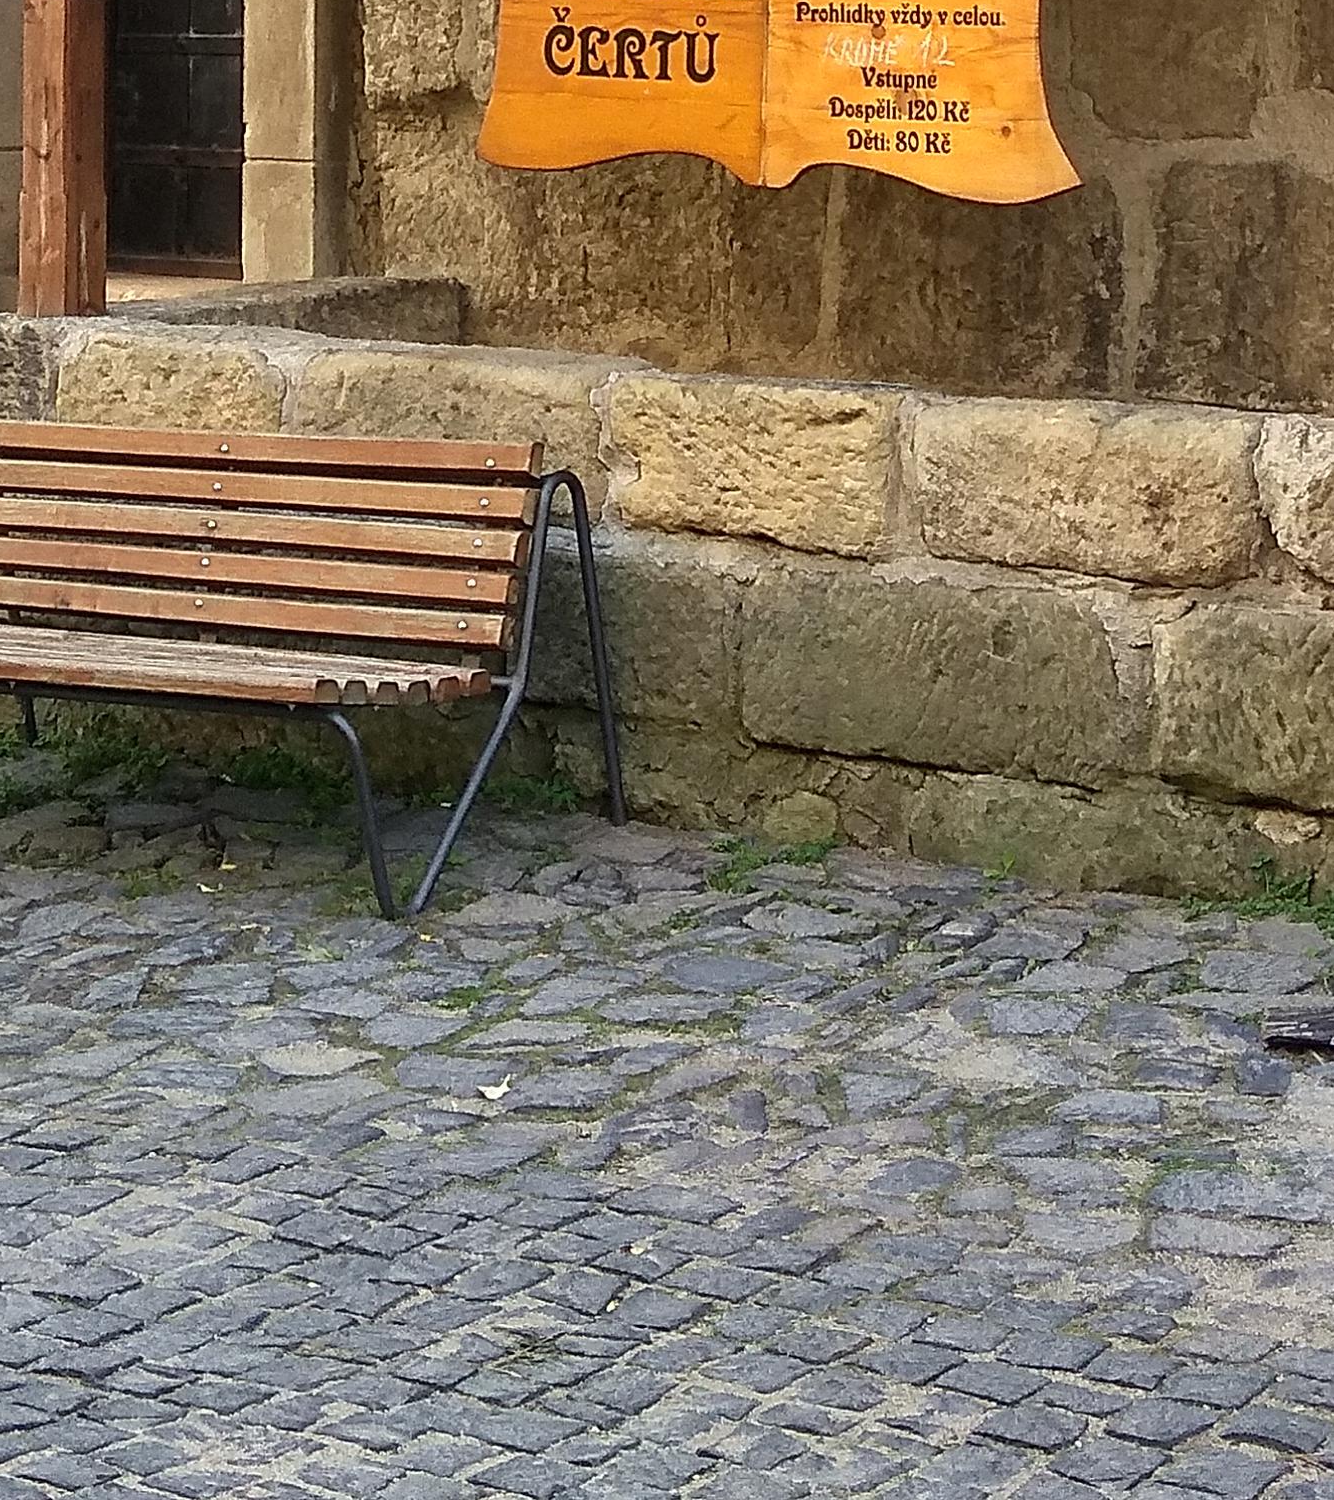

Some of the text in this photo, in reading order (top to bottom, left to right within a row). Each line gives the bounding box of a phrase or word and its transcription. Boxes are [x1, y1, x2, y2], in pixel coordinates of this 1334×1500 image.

[796, 1, 1006, 29] Prohlídky vždy v celou.
[544, 7, 720, 84] ČERTŮ
[915, 30, 955, 67] 12
[861, 67, 937, 93] Vstupné
[829, 96, 970, 123] Dospělí: 120 Kč
[847, 129, 951, 154] Děti: 80 Kč
